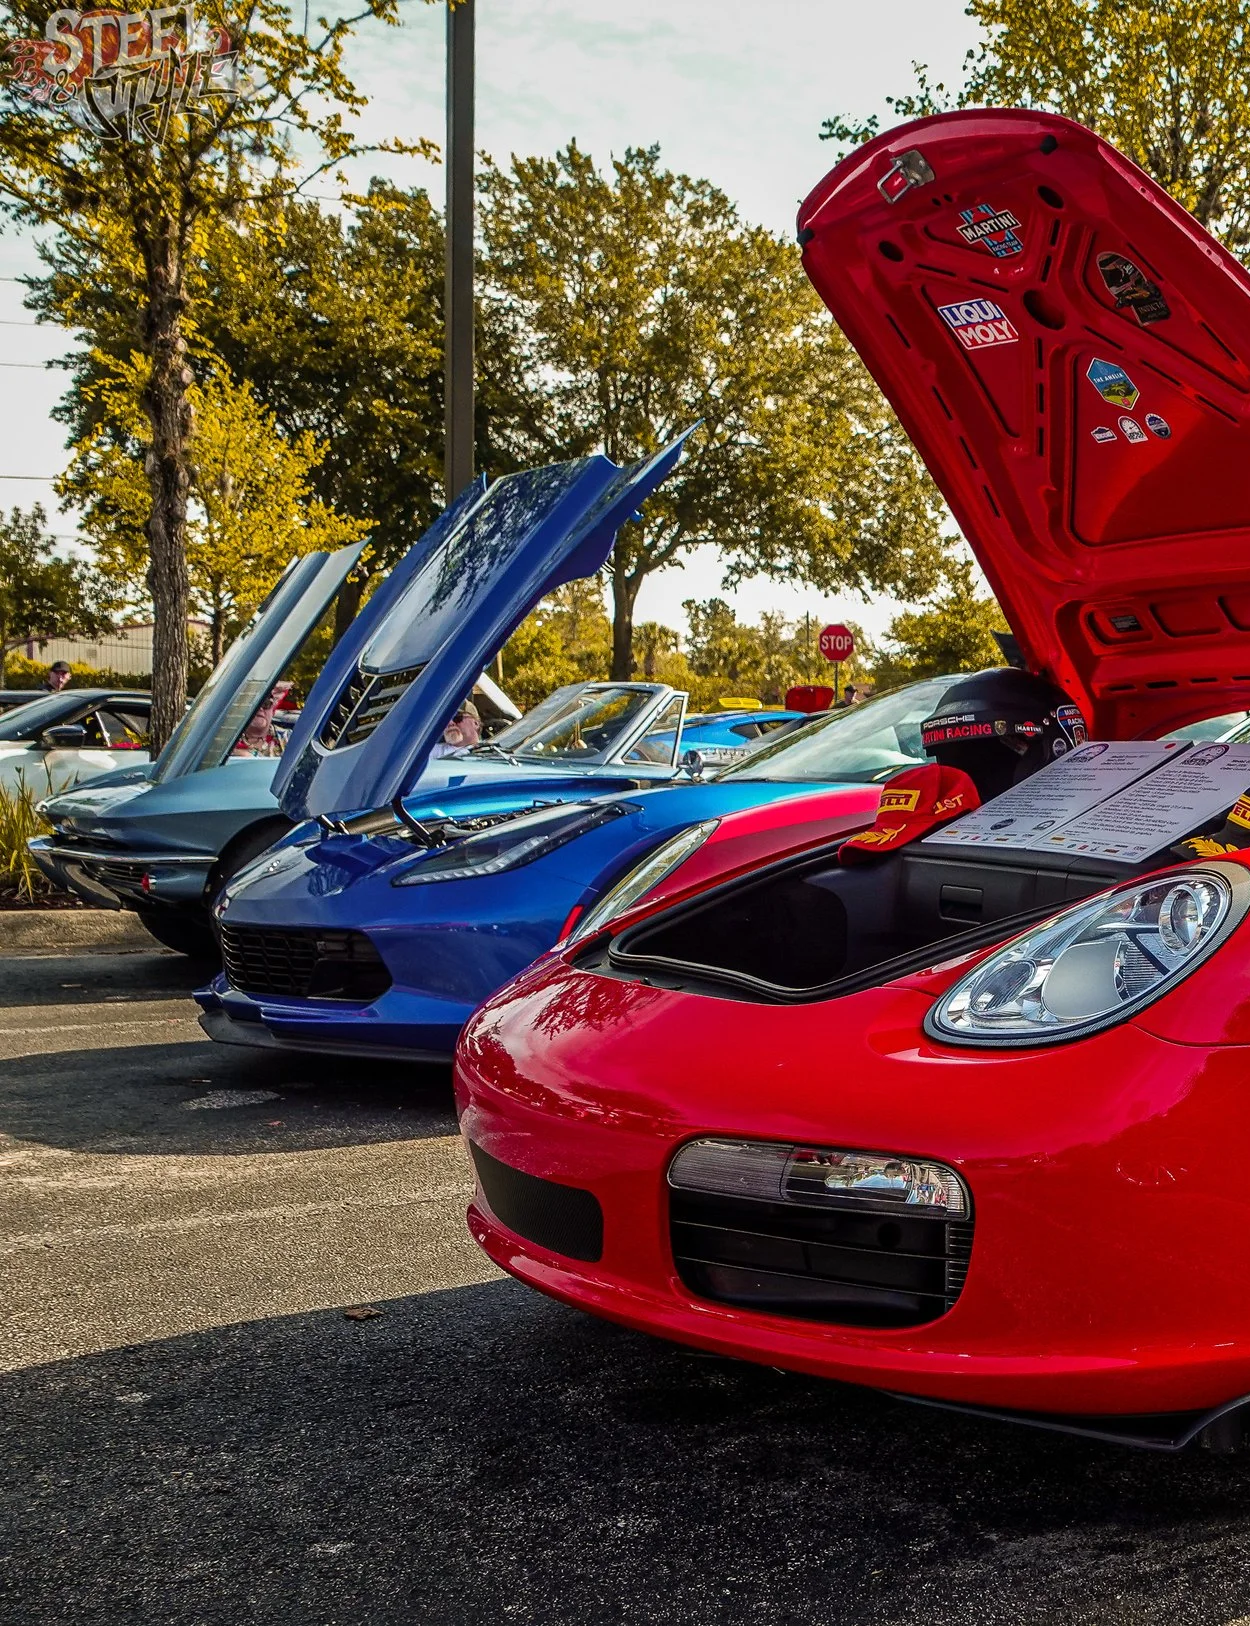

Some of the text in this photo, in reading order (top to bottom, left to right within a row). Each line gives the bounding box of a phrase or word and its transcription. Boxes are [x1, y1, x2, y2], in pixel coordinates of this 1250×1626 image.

[962, 213, 1016, 240] MARTINI
[942, 300, 1002, 327] LIQUI
[957, 320, 1013, 346] MOLY
[821, 634, 852, 650] STOP
[922, 714, 976, 730] PORSCHE
[946, 723, 993, 739] RACING
[934, 793, 964, 815] 1ST
